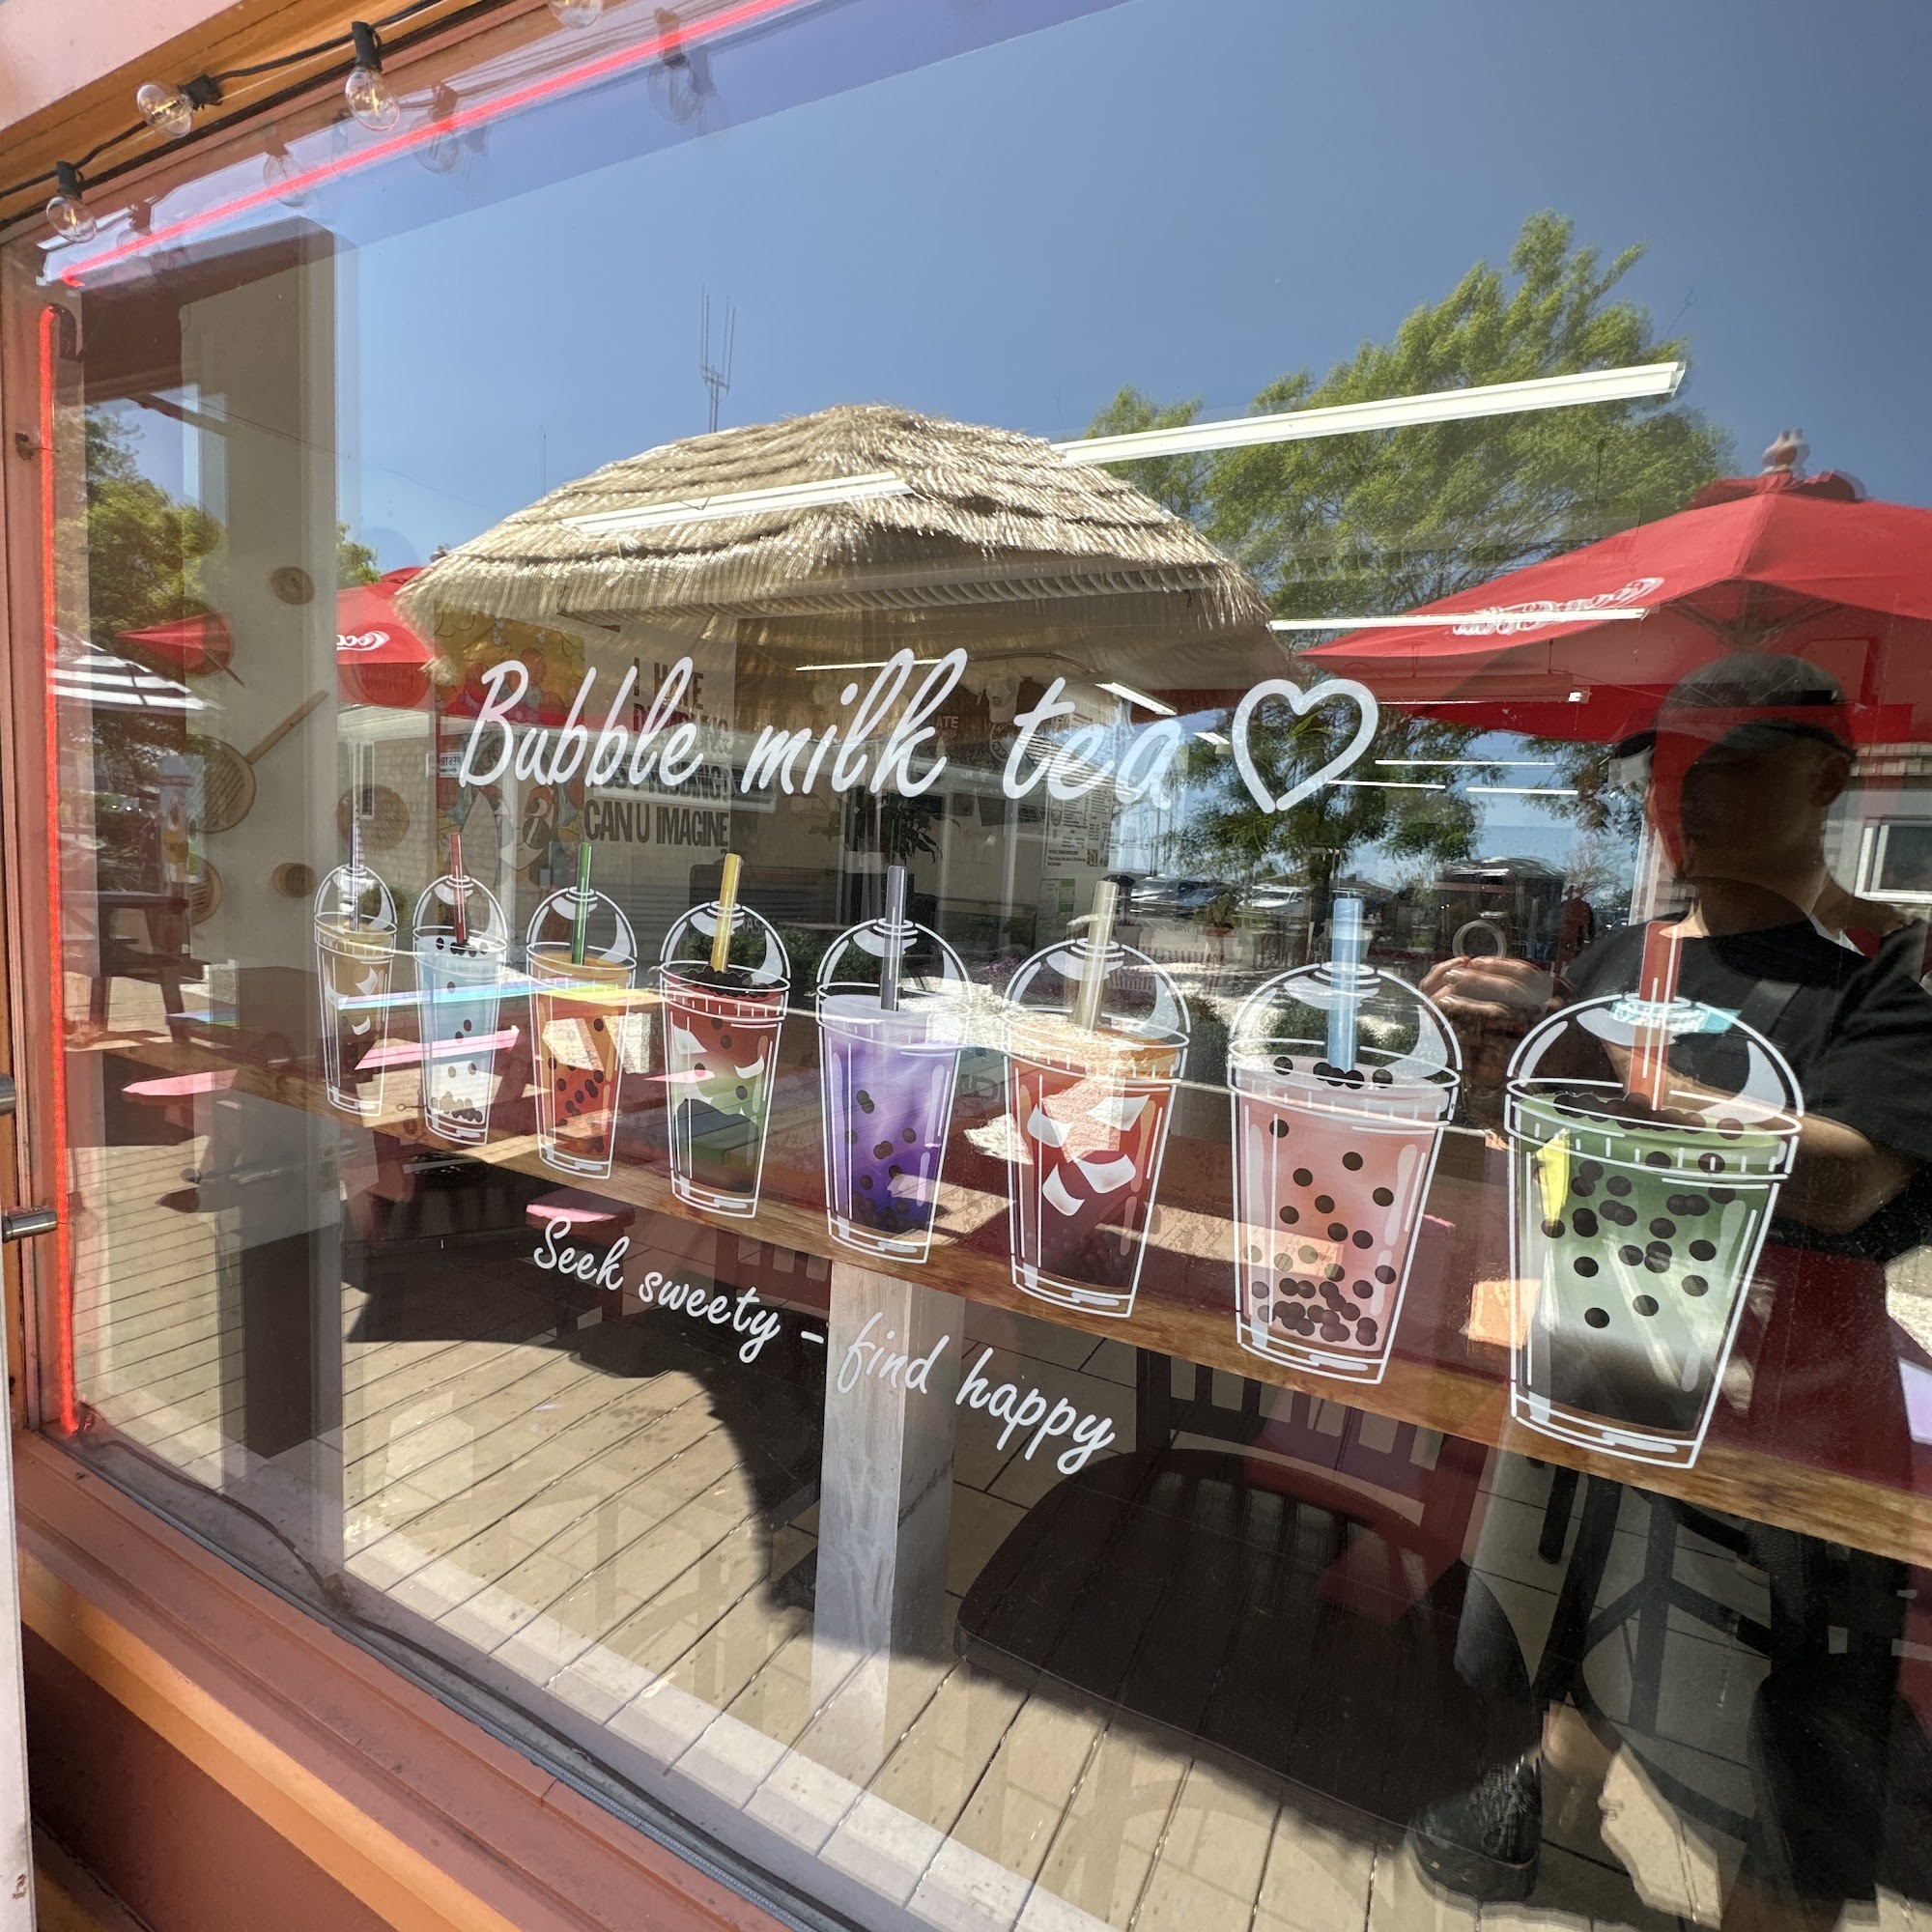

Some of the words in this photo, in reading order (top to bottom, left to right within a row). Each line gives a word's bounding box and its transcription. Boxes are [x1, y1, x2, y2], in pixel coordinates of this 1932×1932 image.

[459, 657, 704, 787] Bubble
[741, 648, 967, 797] milk
[1002, 676, 1182, 809] tea
[583, 800, 633, 843] CAN
[636, 803, 650, 843] U
[656, 806, 730, 848] IMAGINE
[533, 1215, 631, 1291] Seek
[639, 1268, 781, 1363] sweety
[837, 1312, 950, 1394] find
[955, 1348, 1115, 1475] happy
